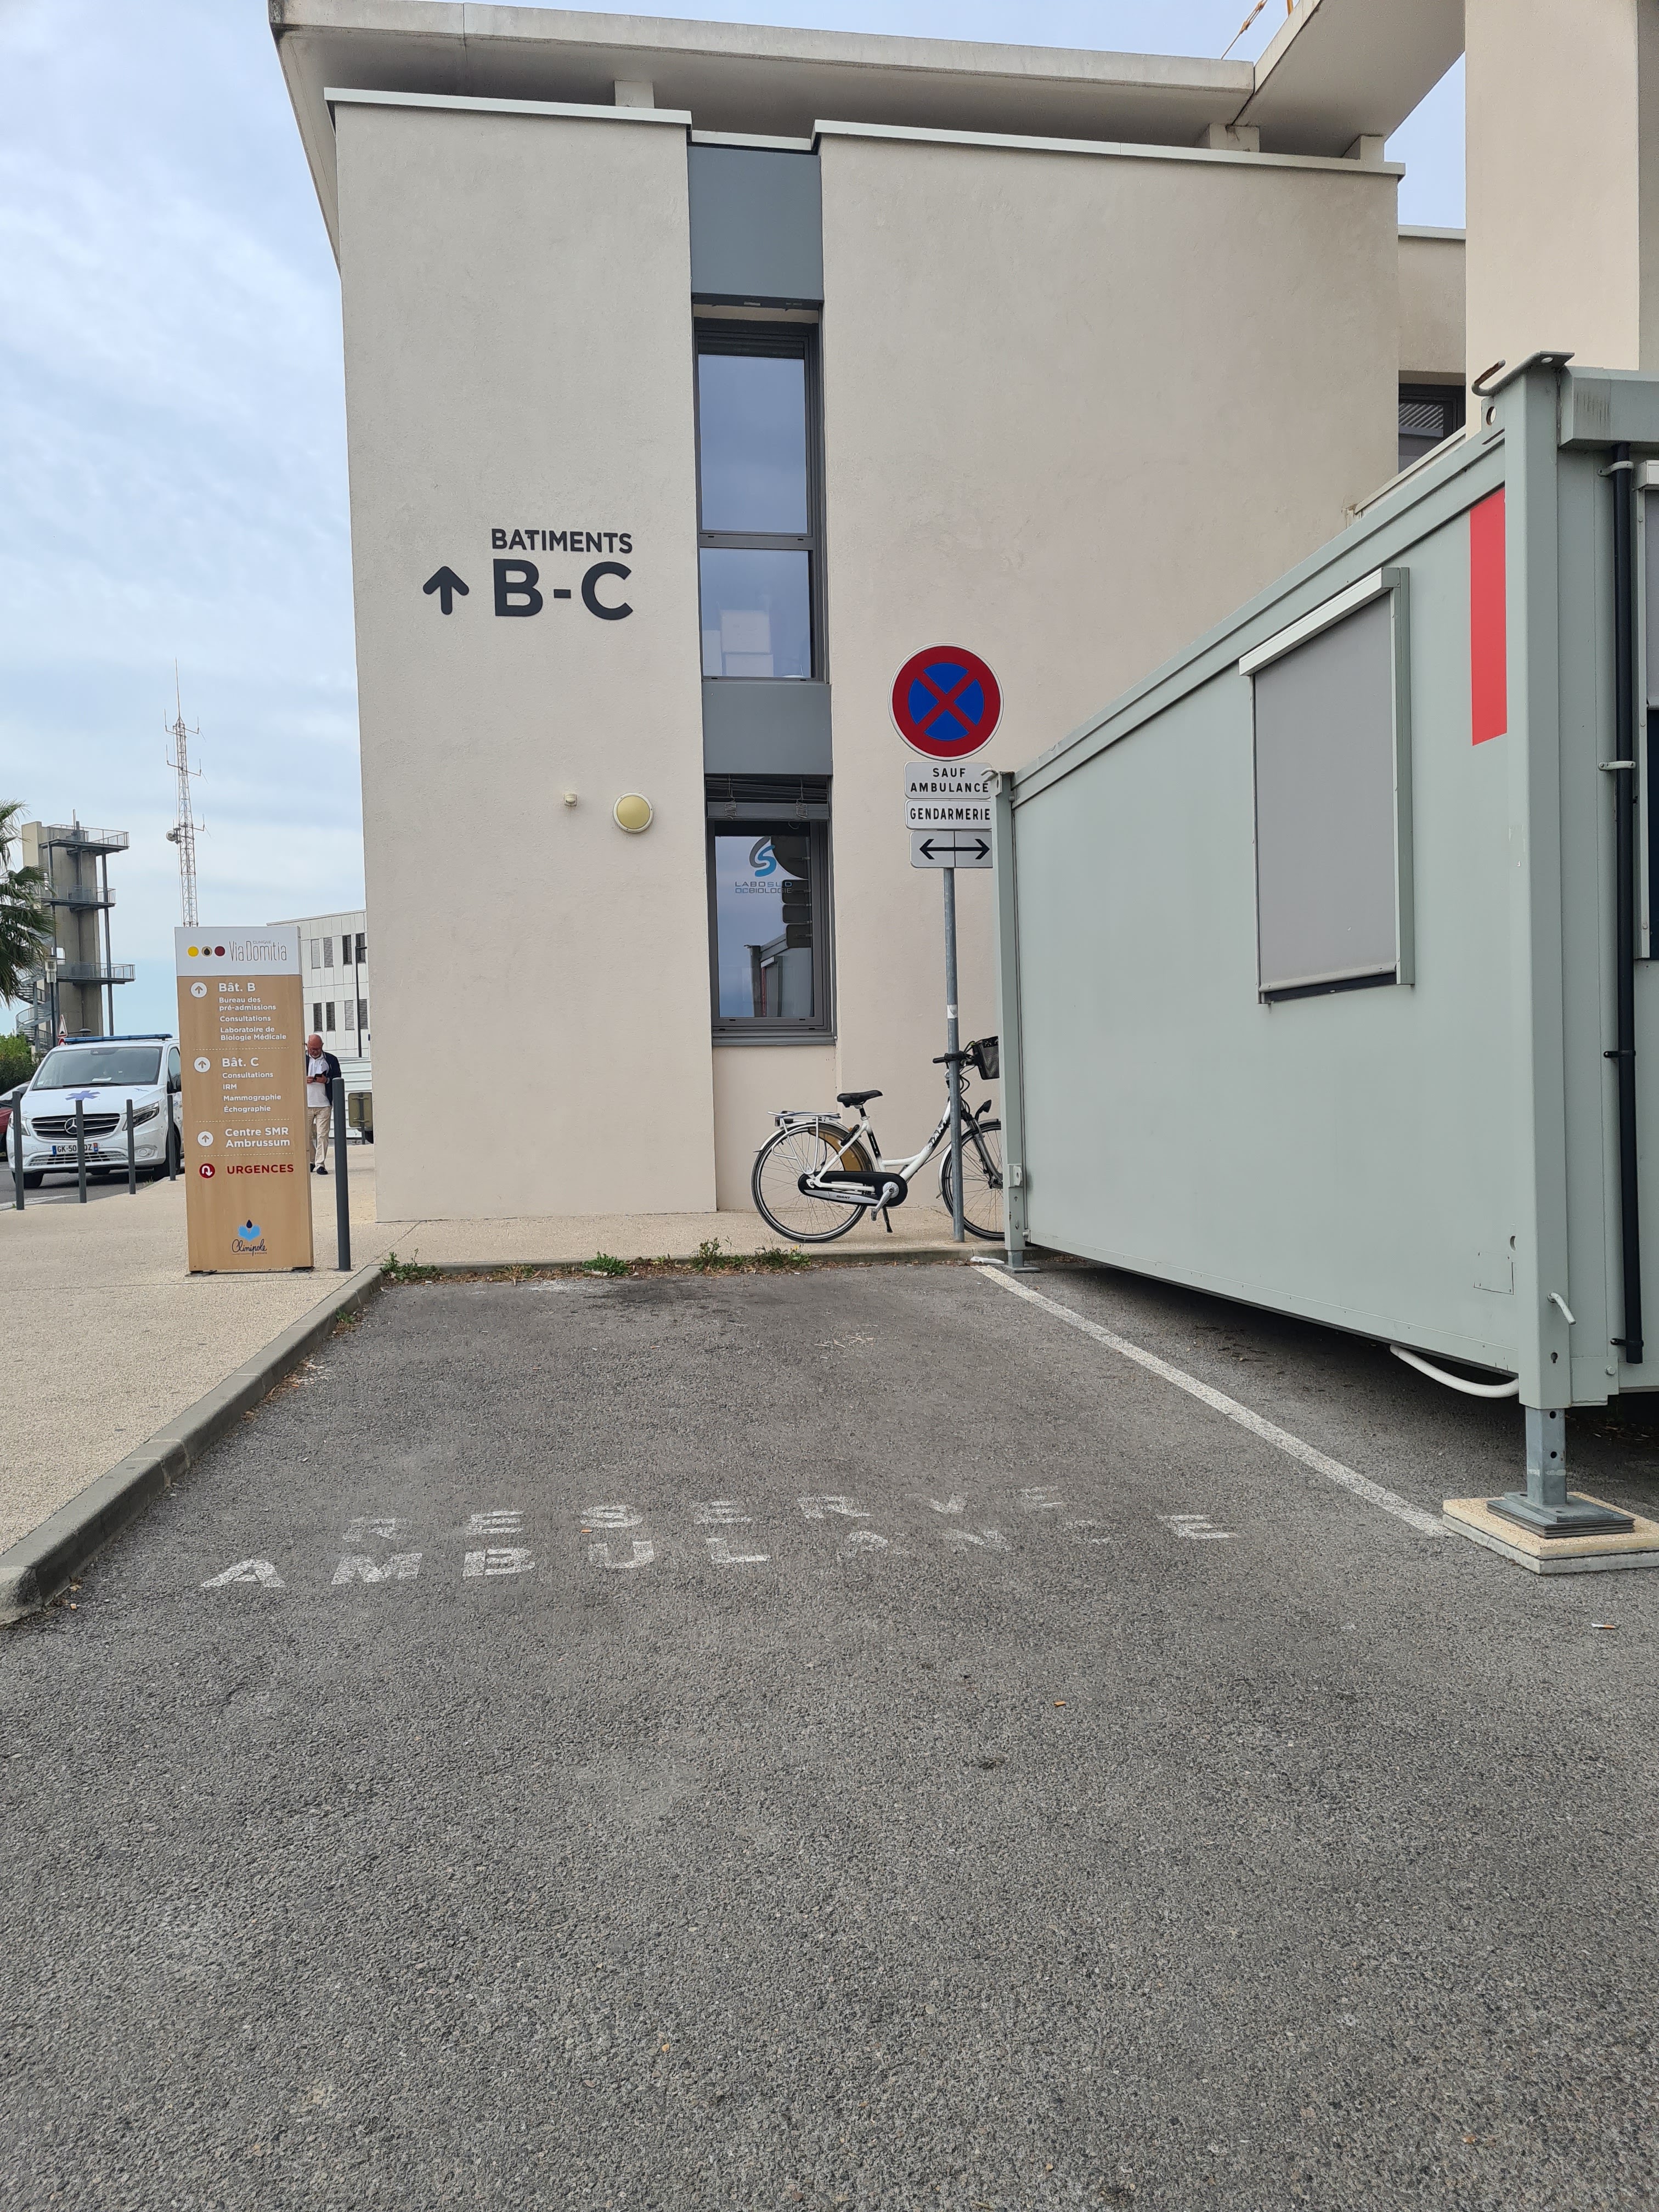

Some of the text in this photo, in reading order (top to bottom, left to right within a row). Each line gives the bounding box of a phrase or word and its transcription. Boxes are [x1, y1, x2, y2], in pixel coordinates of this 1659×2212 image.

[492, 528, 633, 554] BATIMENTS
[493, 558, 633, 620] B-C
[933, 768, 966, 777] SAUF
[910, 782, 989, 792] AMBULANCE
[910, 808, 990, 820] GENDARMERIE
[218, 982, 256, 992] Bât. B
[219, 1004, 276, 1012] pré-admissions
[222, 1057, 259, 1067] Bât. C
[223, 1093, 281, 1102] Mammographie
[224, 1105, 271, 1113] Échographie
[225, 1127, 289, 1137] Centre SMR
[225, 1139, 290, 1148] Ambrussum
[227, 1164, 294, 1175] URGENCES
